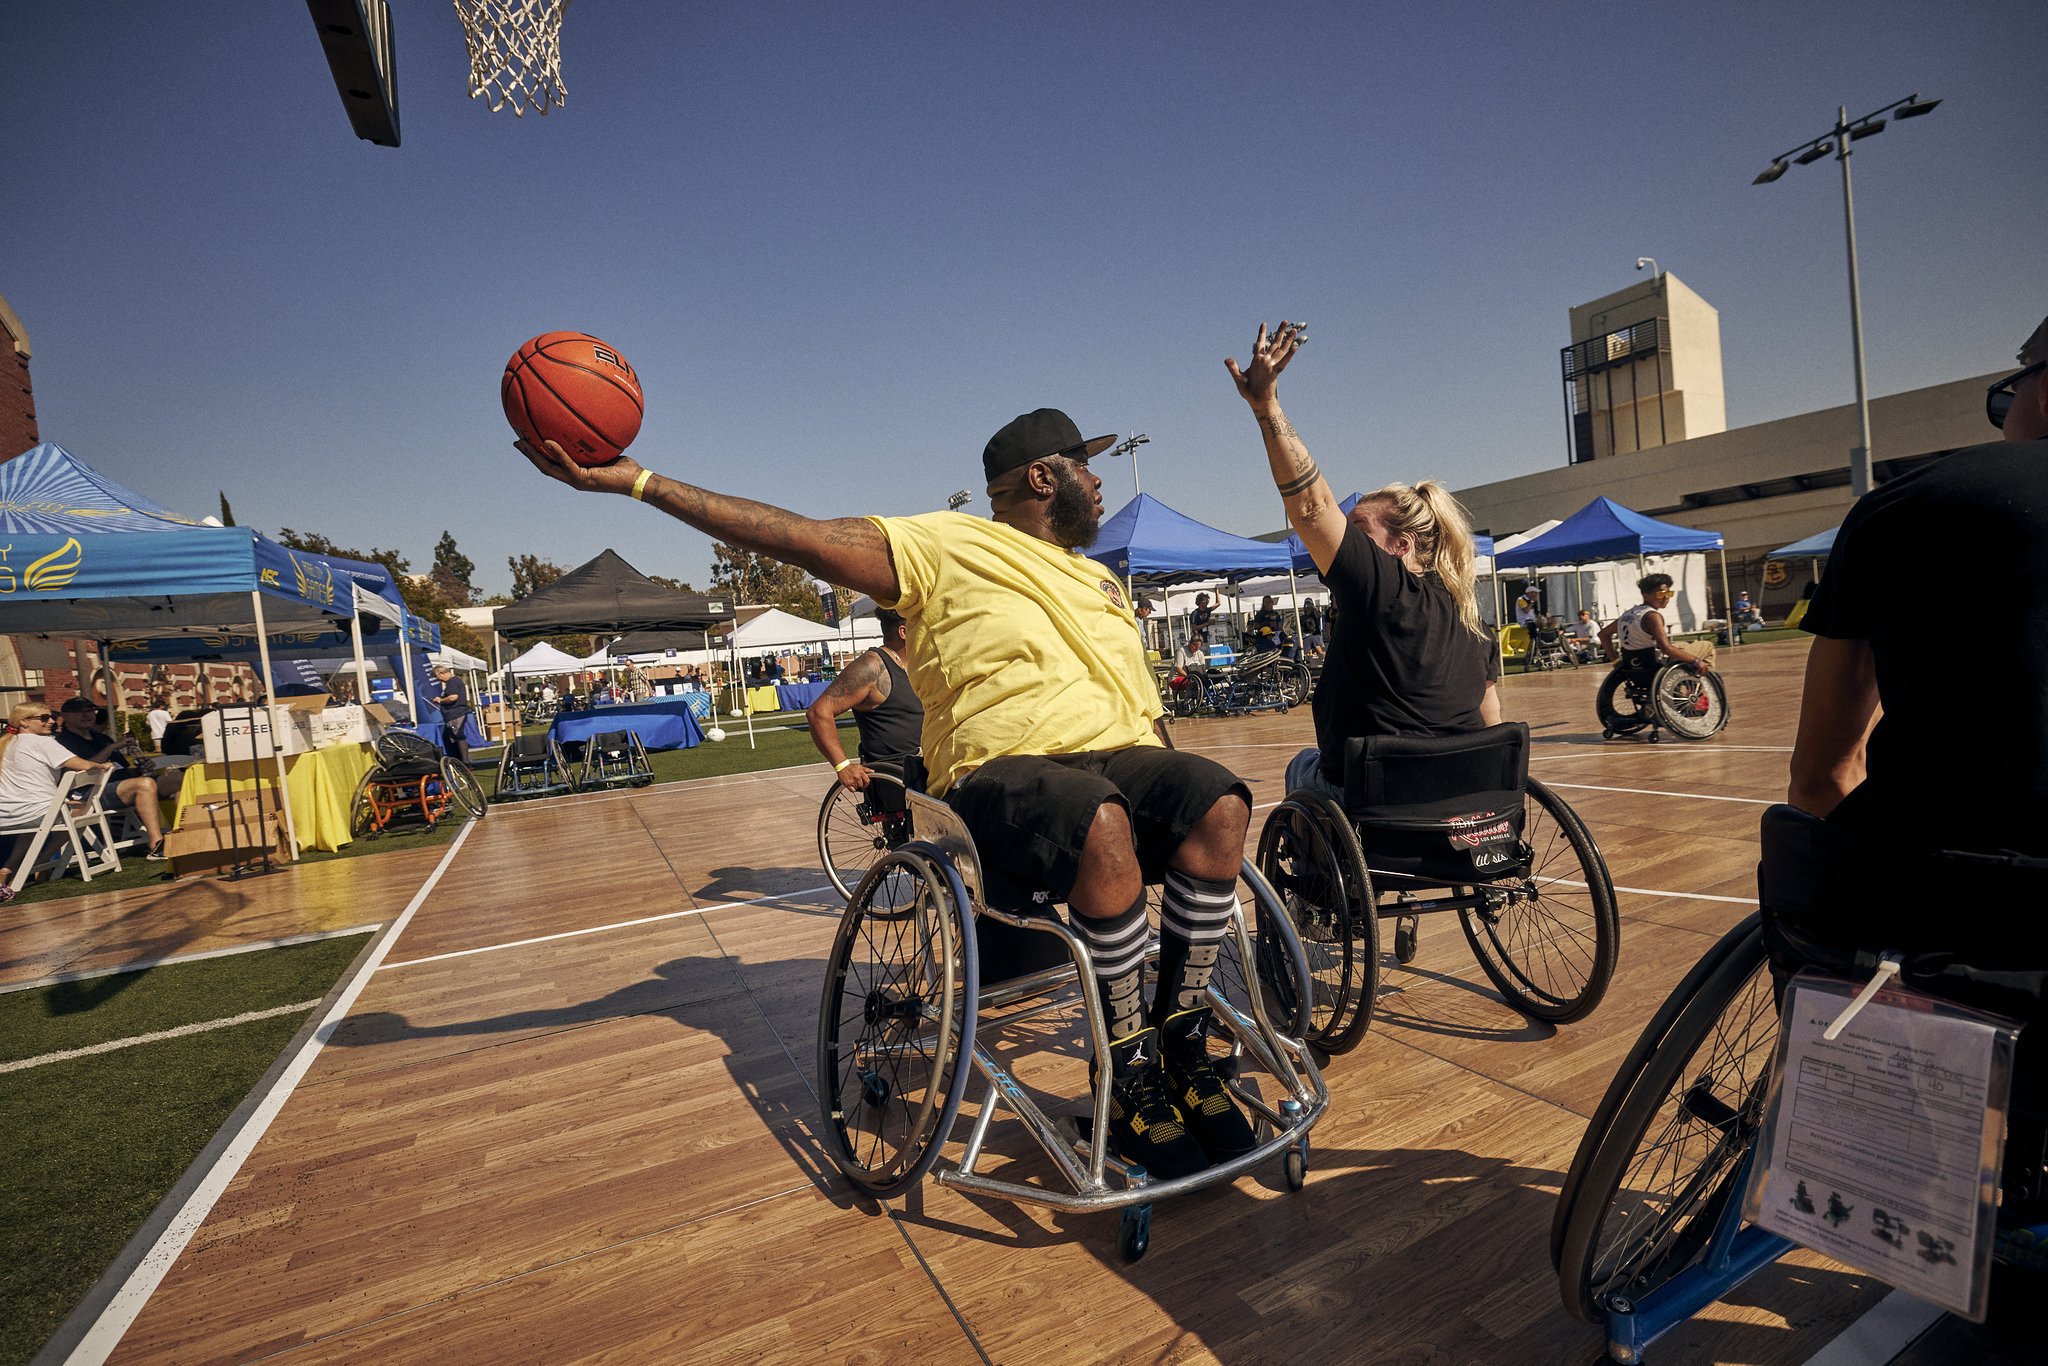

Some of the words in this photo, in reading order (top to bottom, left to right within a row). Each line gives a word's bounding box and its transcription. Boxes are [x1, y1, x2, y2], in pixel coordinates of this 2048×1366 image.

[214, 724, 272, 738] JERZEE
[1475, 853, 1490, 867] lil
[1492, 852, 1509, 864] sis
